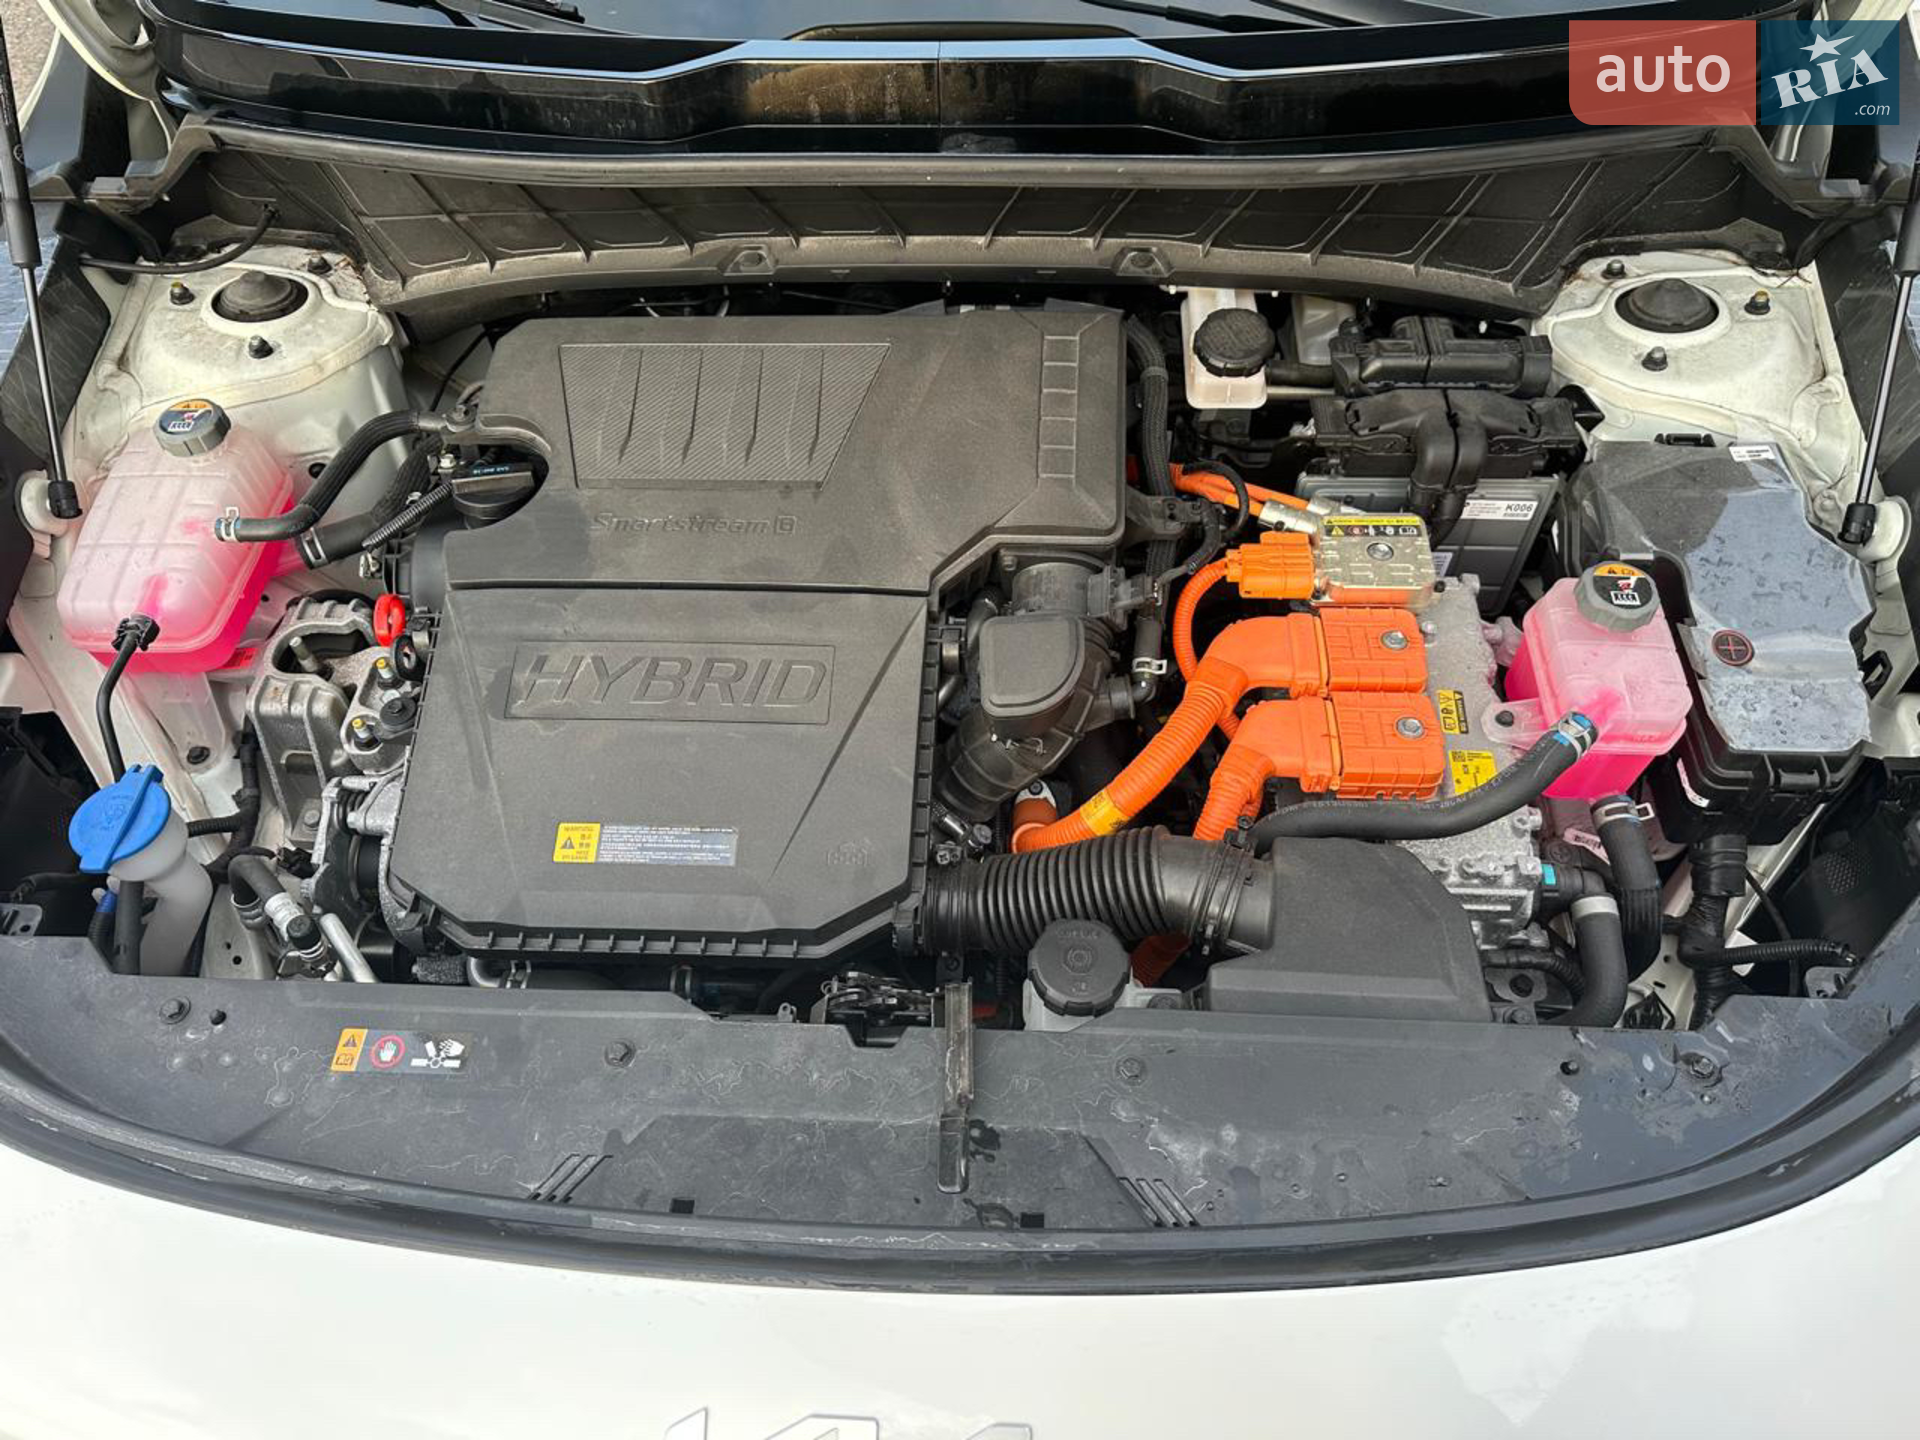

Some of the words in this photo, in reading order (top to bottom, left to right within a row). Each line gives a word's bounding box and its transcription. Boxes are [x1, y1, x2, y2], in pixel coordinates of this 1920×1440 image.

[1505, 503, 1534, 512] K006
[591, 512, 770, 534] Smartstream
[516, 655, 827, 707] HYBRID
